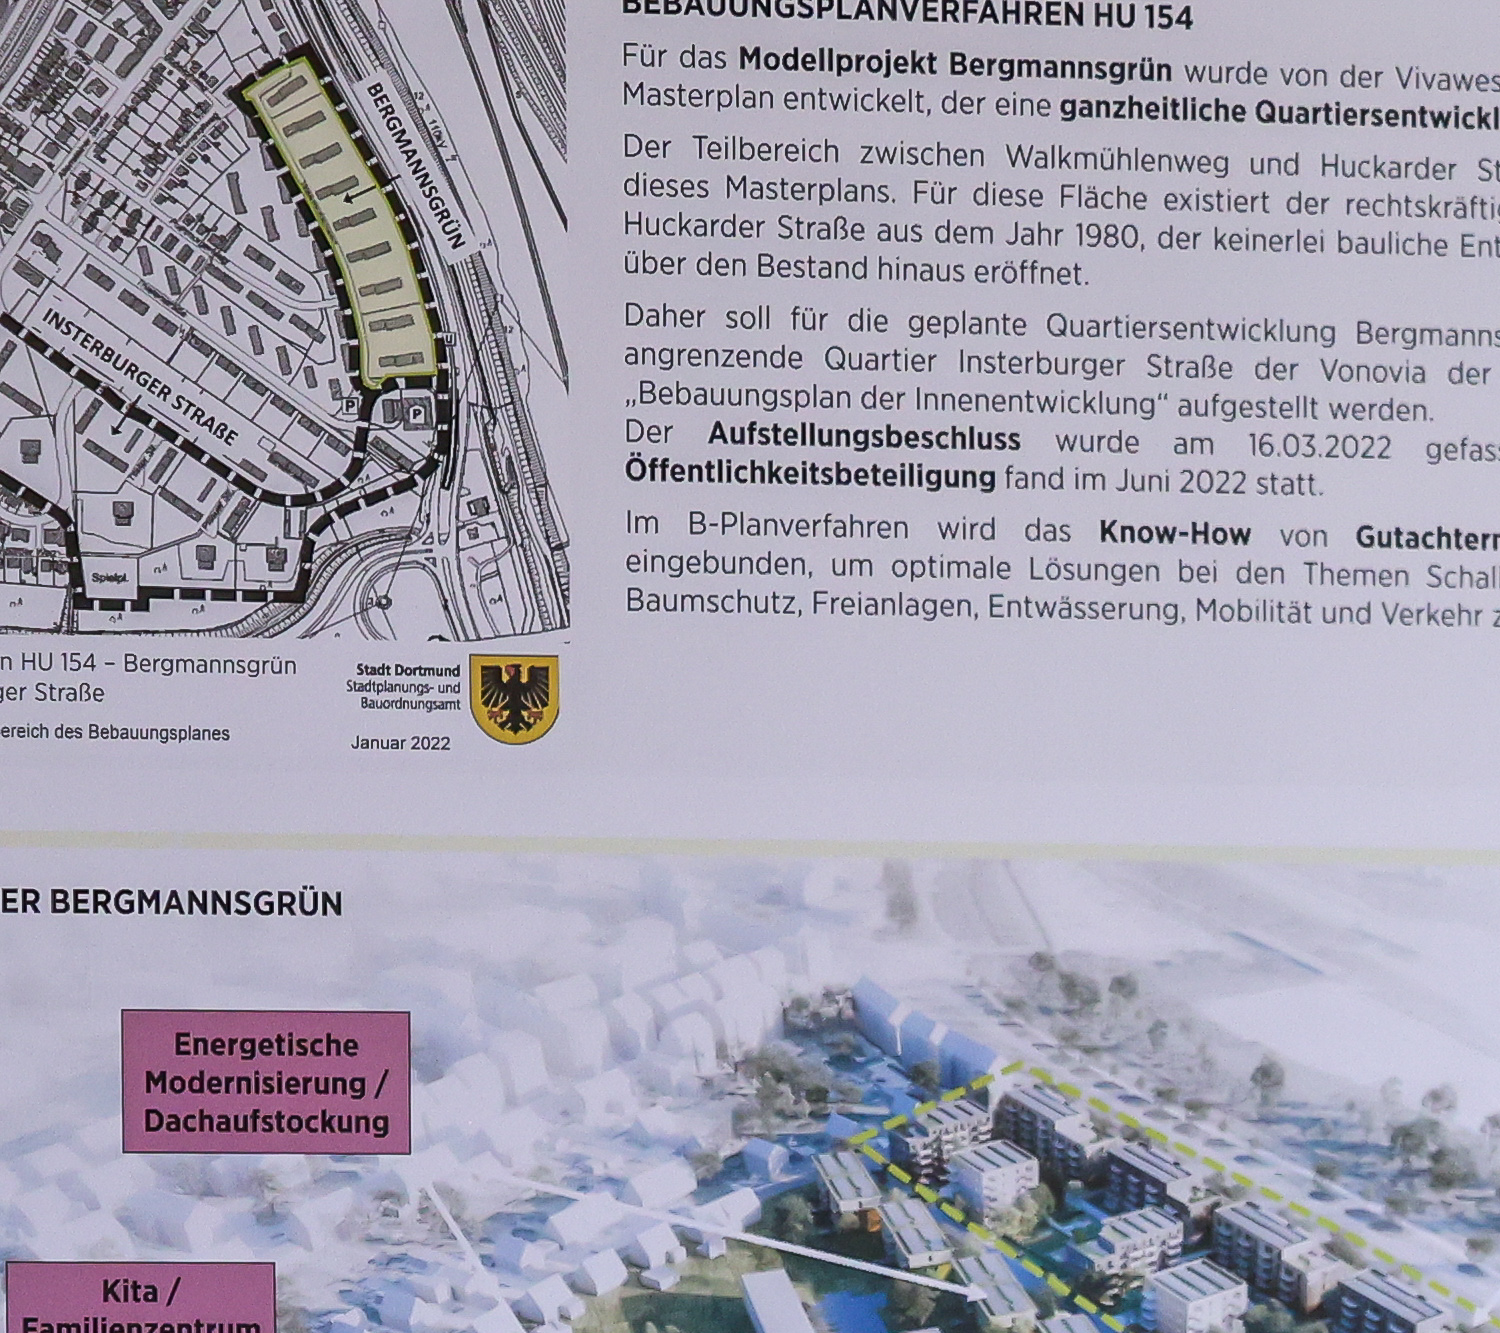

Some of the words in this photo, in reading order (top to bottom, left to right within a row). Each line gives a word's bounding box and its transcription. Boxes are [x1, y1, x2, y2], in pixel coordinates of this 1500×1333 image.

[622, 0, 1084, 27] BEBAUUNGSPLANVERFAHREN
[1094, 2, 1136, 28] HU
[1144, 4, 1194, 30] 154
[623, 42, 668, 68] Für
[679, 43, 727, 70] das
[739, 45, 938, 79] Modellprojekt
[949, 51, 1172, 86] Bergmannsgrün
[1184, 60, 1268, 85] wurde
[1280, 68, 1328, 87] von
[1340, 64, 1384, 89] der
[366, 81, 467, 251] BERGMANNSGRÜN
[42, 307, 172, 398] INSTERBURGER
[625, 456, 996, 494] Öffentlichkeitsbeteiligung
[1005, 464, 1064, 491] fand
[1075, 473, 1106, 491] im
[1116, 468, 1169, 492] Juni
[1180, 469, 1246, 495] 2022
[1257, 473, 1323, 496] statt.
[21, 652, 53, 672] HU
[60, 652, 97, 672] 154
[124, 652, 297, 678] Bergmannsgrün
[356, 662, 392, 677] Stadt
[394, 663, 461, 678] Dortmund
[34, 682, 105, 703] Straße
[346, 679, 435, 697] Stadtplanungs-
[437, 681, 461, 695] und
[360, 696, 462, 714] Bauordnungsamt
[54, 723, 83, 740] des
[88, 723, 231, 745] Bebauungsplanes
[350, 735, 407, 750] Januar
[410, 735, 451, 751] 2022
[50, 885, 342, 917] BERGMANNSGRÜN
[175, 1031, 359, 1061] Energetische
[145, 1069, 366, 1100] Modernisierung
[144, 1108, 389, 1139] Dachaufstockung
[102, 1278, 158, 1304] Kita
